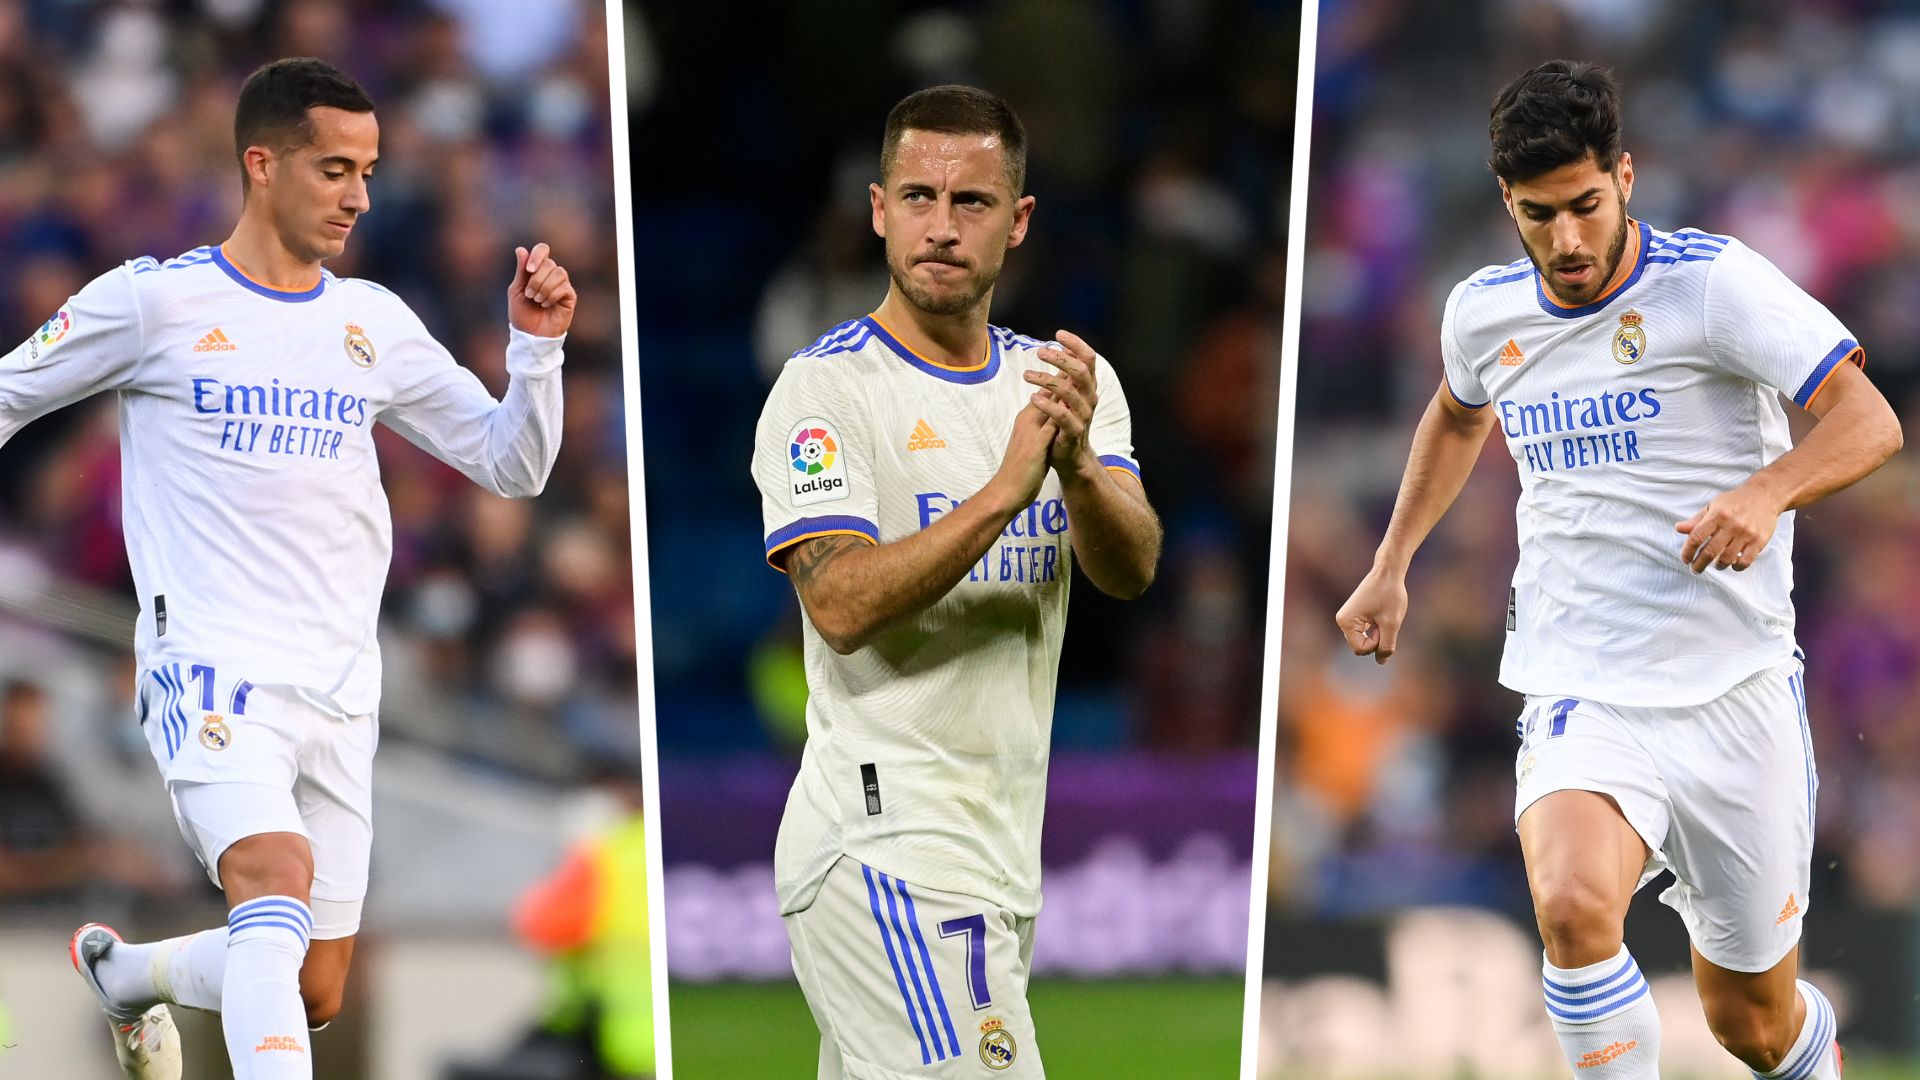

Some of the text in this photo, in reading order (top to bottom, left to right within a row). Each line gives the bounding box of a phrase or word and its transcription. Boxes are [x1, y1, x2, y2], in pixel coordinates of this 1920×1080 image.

[192, 342, 236, 352] adidas
[192, 377, 368, 427] Emirates
[1500, 387, 1661, 438] Emirates
[219, 421, 343, 460] FLY BETTER
[907, 438, 946, 451] adidas
[1524, 430, 1641, 473] FLY BETTER
[794, 476, 843, 495] LaLiga
[937, 914, 992, 1011] 7
[263, 1035, 298, 1044] REAL
[1583, 1041, 1624, 1061] REAL
[1576, 1041, 1638, 1069] MADRID
